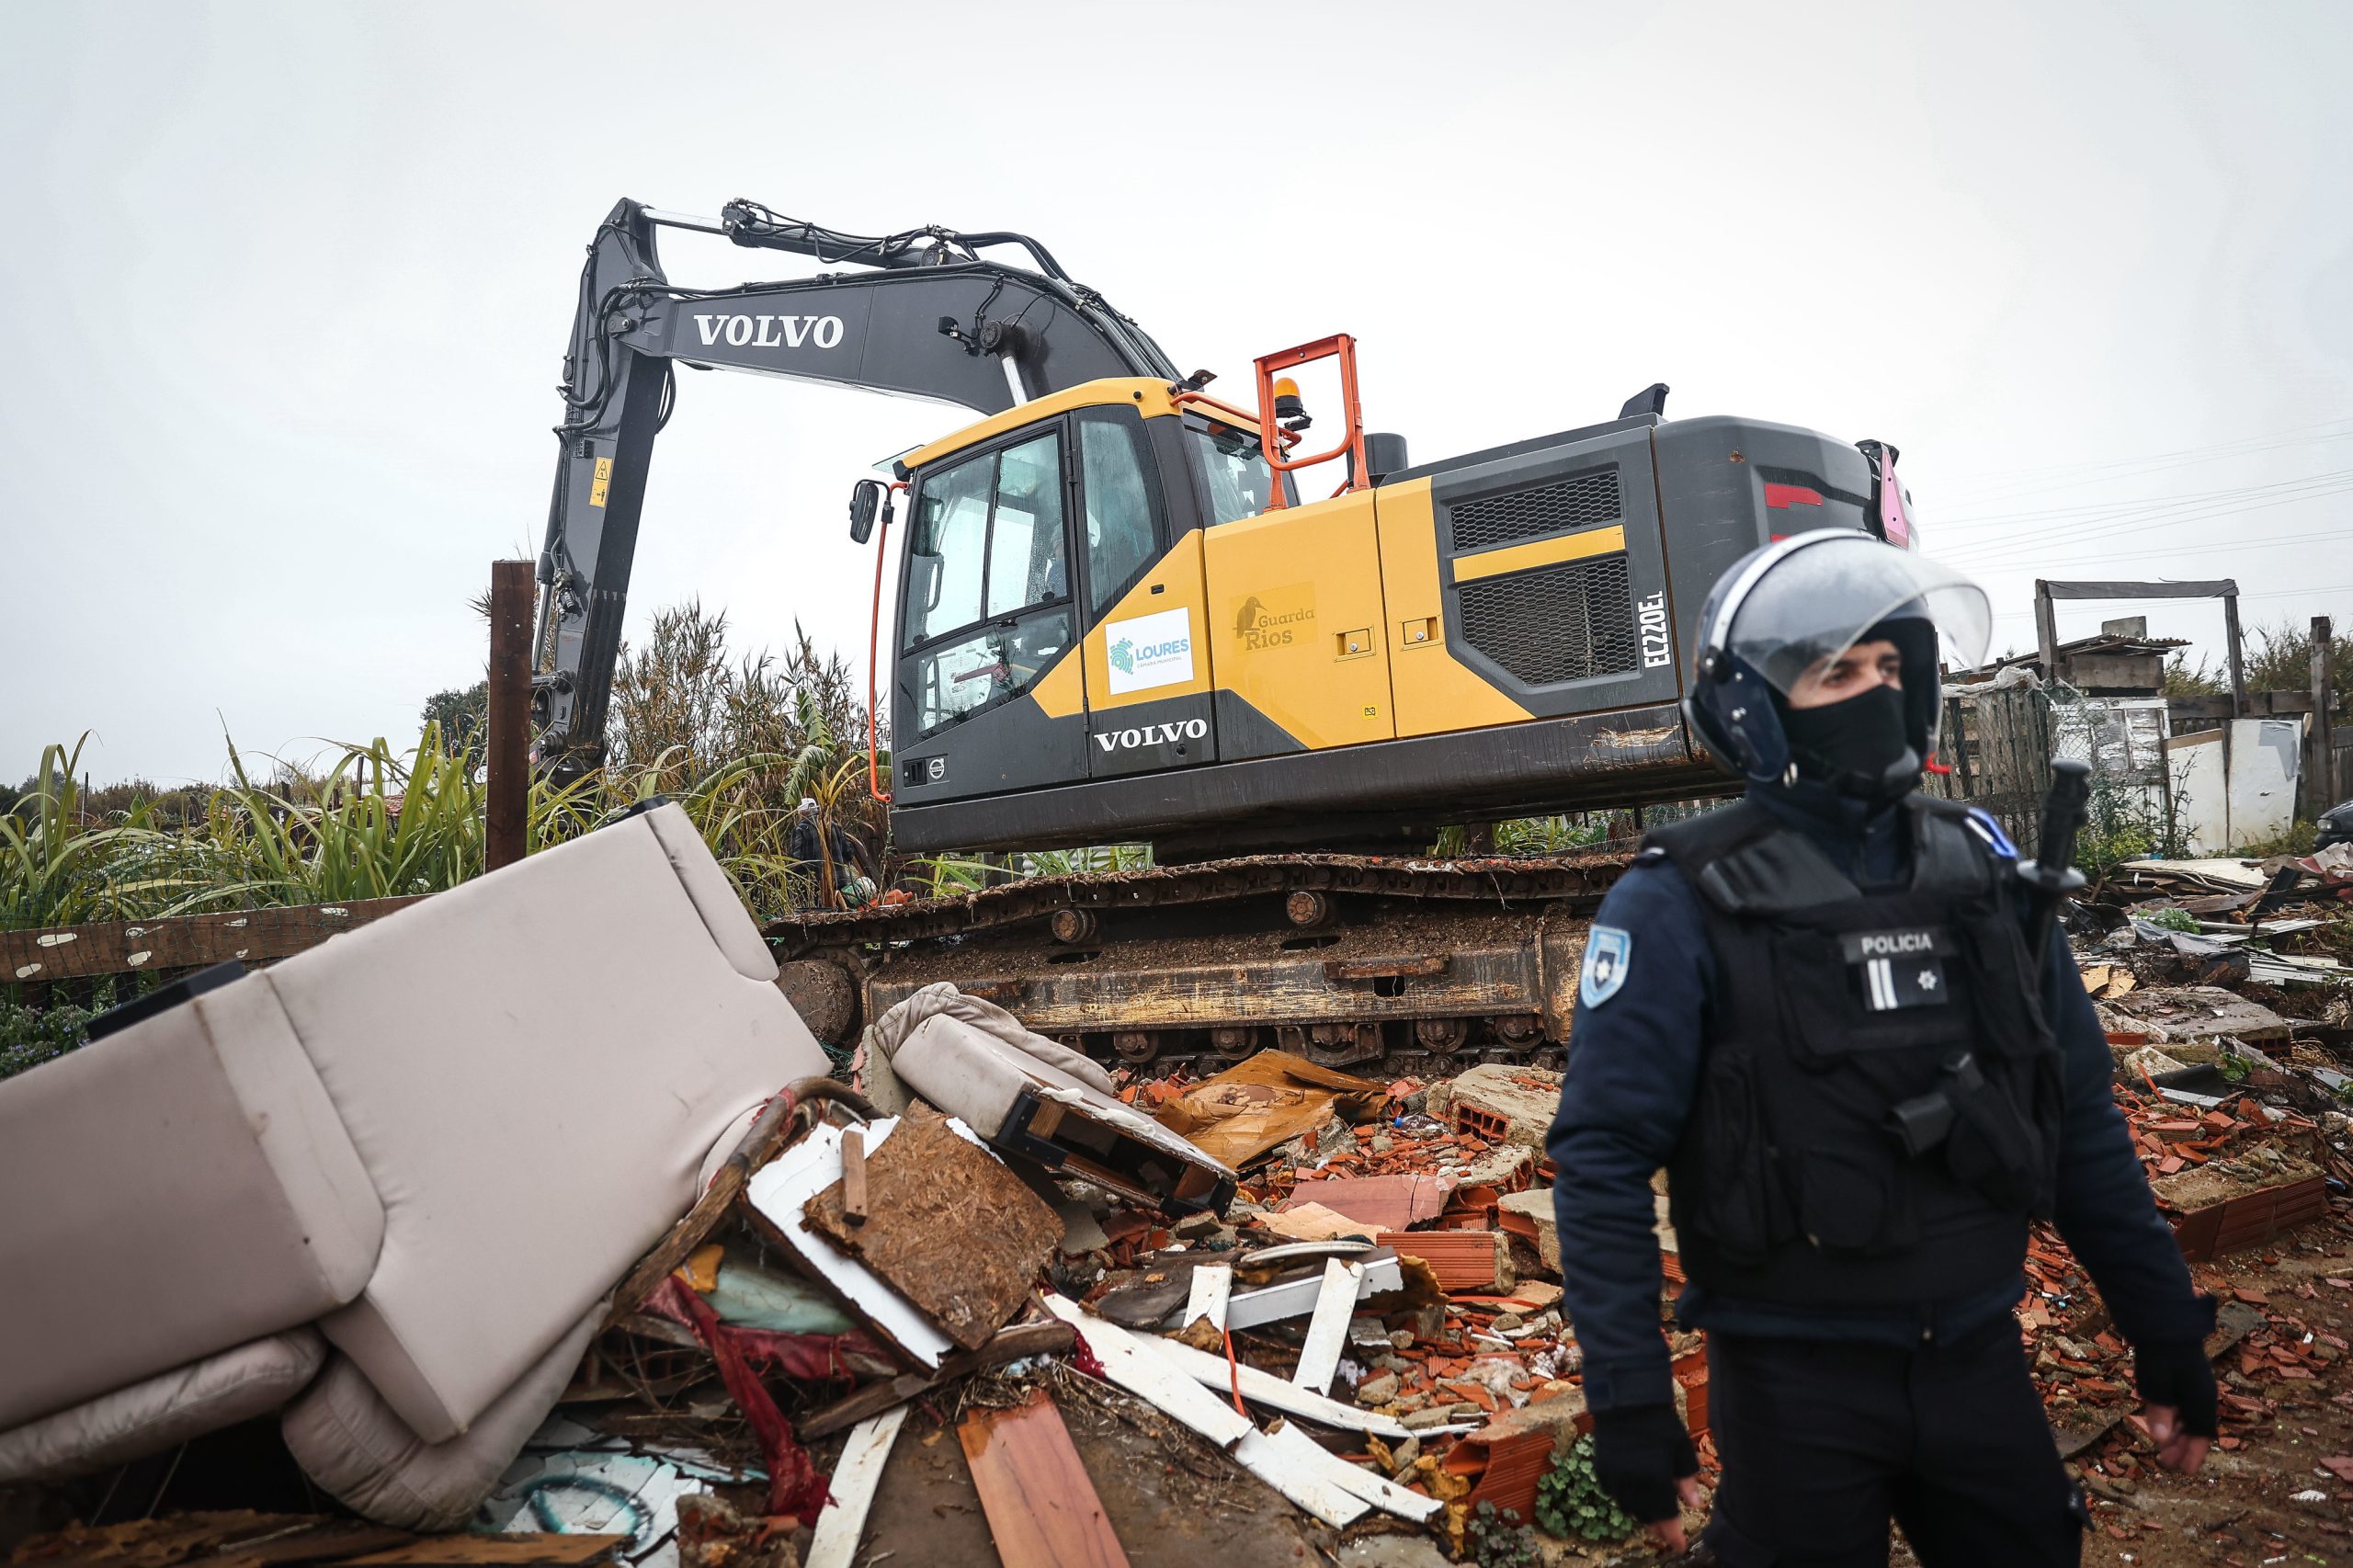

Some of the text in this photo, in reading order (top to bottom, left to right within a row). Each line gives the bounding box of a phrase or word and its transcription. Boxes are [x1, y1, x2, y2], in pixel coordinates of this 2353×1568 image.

[693, 314, 845, 348] VOLVO
[1258, 608, 1315, 629] Guarda
[1135, 638, 1189, 661] LOURES
[1245, 629, 1293, 651] Rios
[1094, 718, 1208, 752] VOLVO
